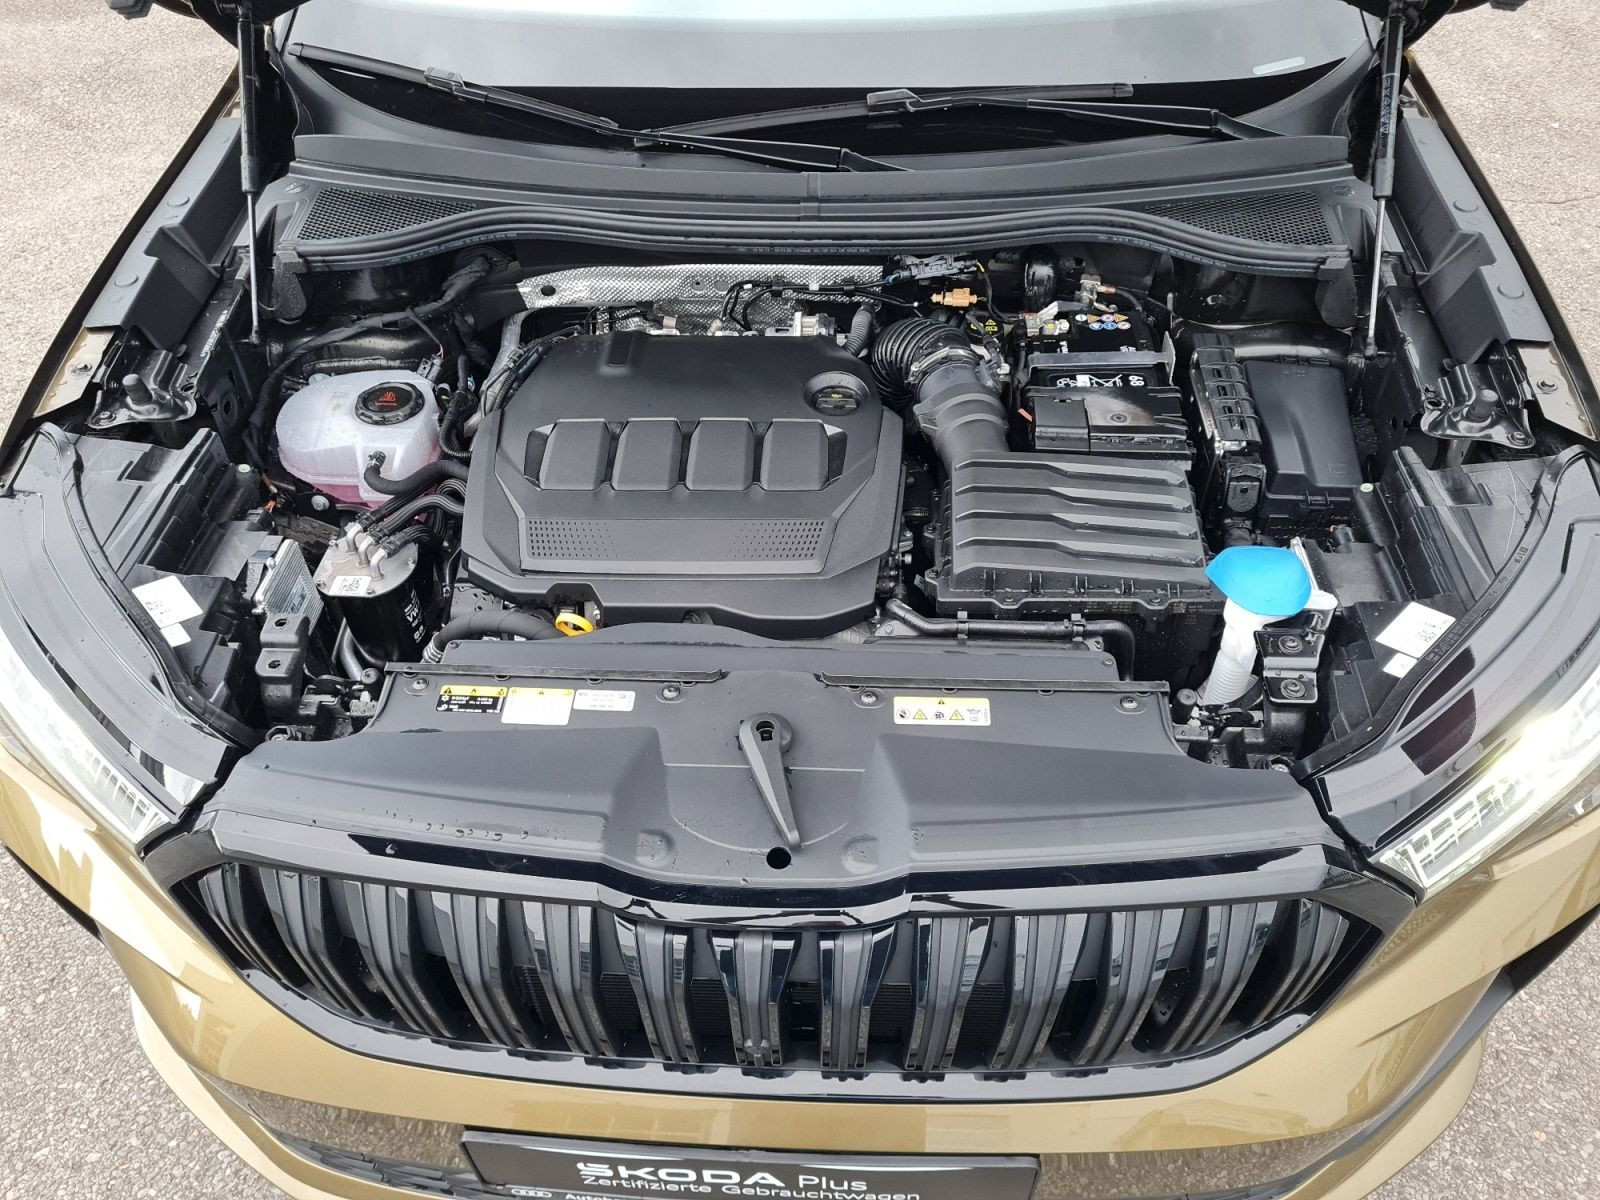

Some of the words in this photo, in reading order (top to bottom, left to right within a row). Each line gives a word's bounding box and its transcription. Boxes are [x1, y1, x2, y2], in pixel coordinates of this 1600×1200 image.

[581, 1175, 712, 1193] Zertifizierte
[721, 1184, 920, 1200] Gebrauchtwagen
[798, 1175, 868, 1191] Plus
